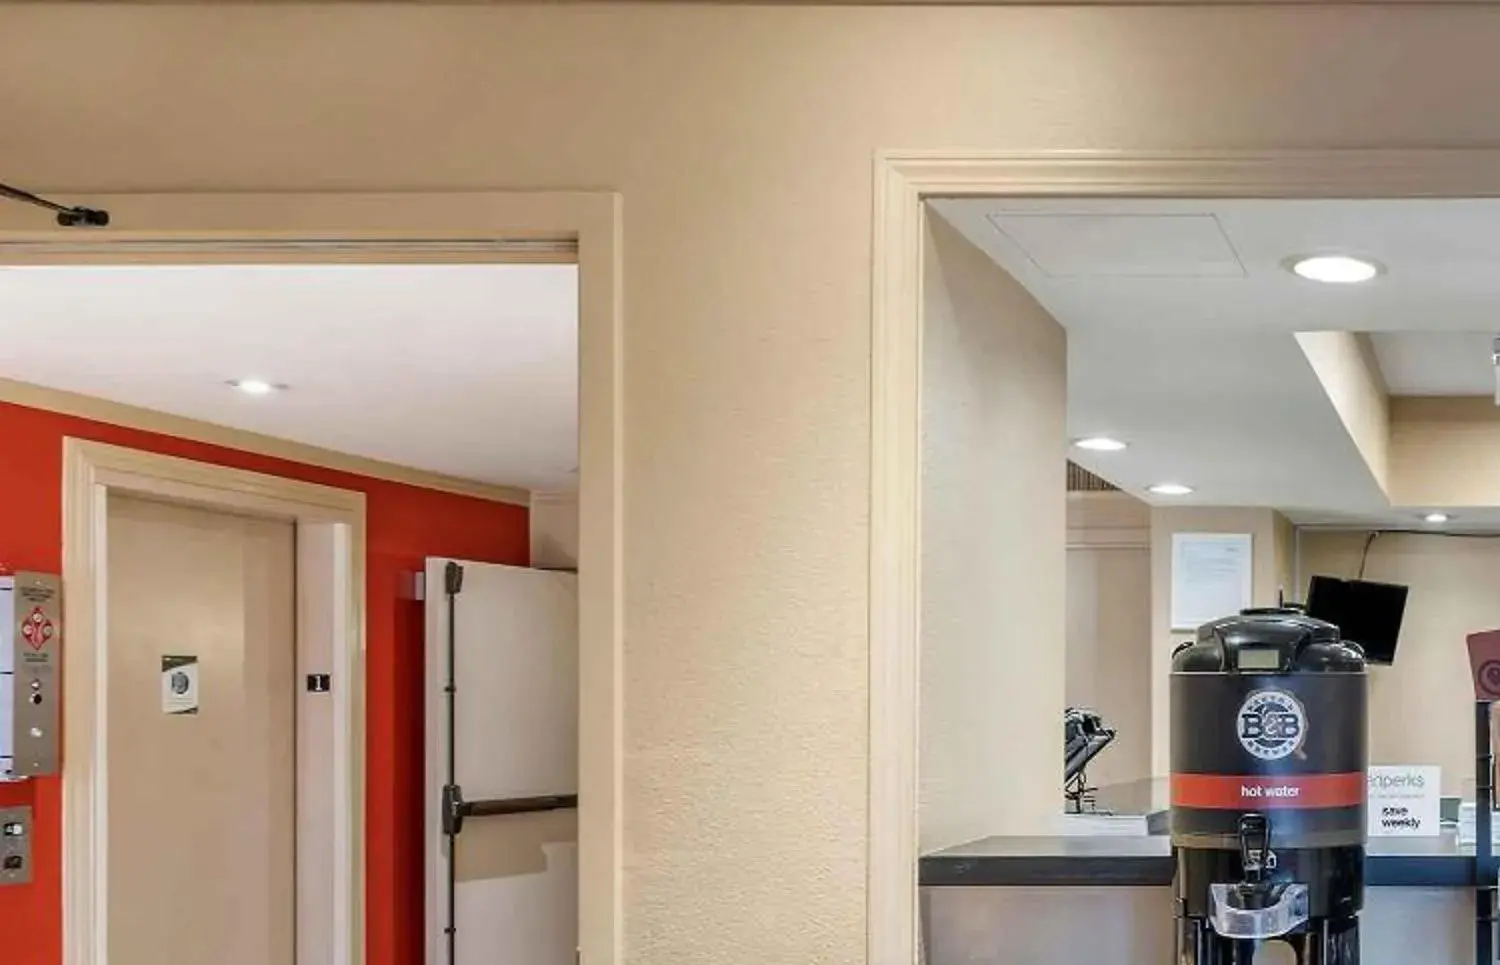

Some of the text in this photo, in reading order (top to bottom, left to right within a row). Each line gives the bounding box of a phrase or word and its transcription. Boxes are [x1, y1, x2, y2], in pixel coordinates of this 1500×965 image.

[315, 676, 323, 691] 1
[1241, 785, 1300, 797] hot water
[1381, 817, 1421, 829] weekly
